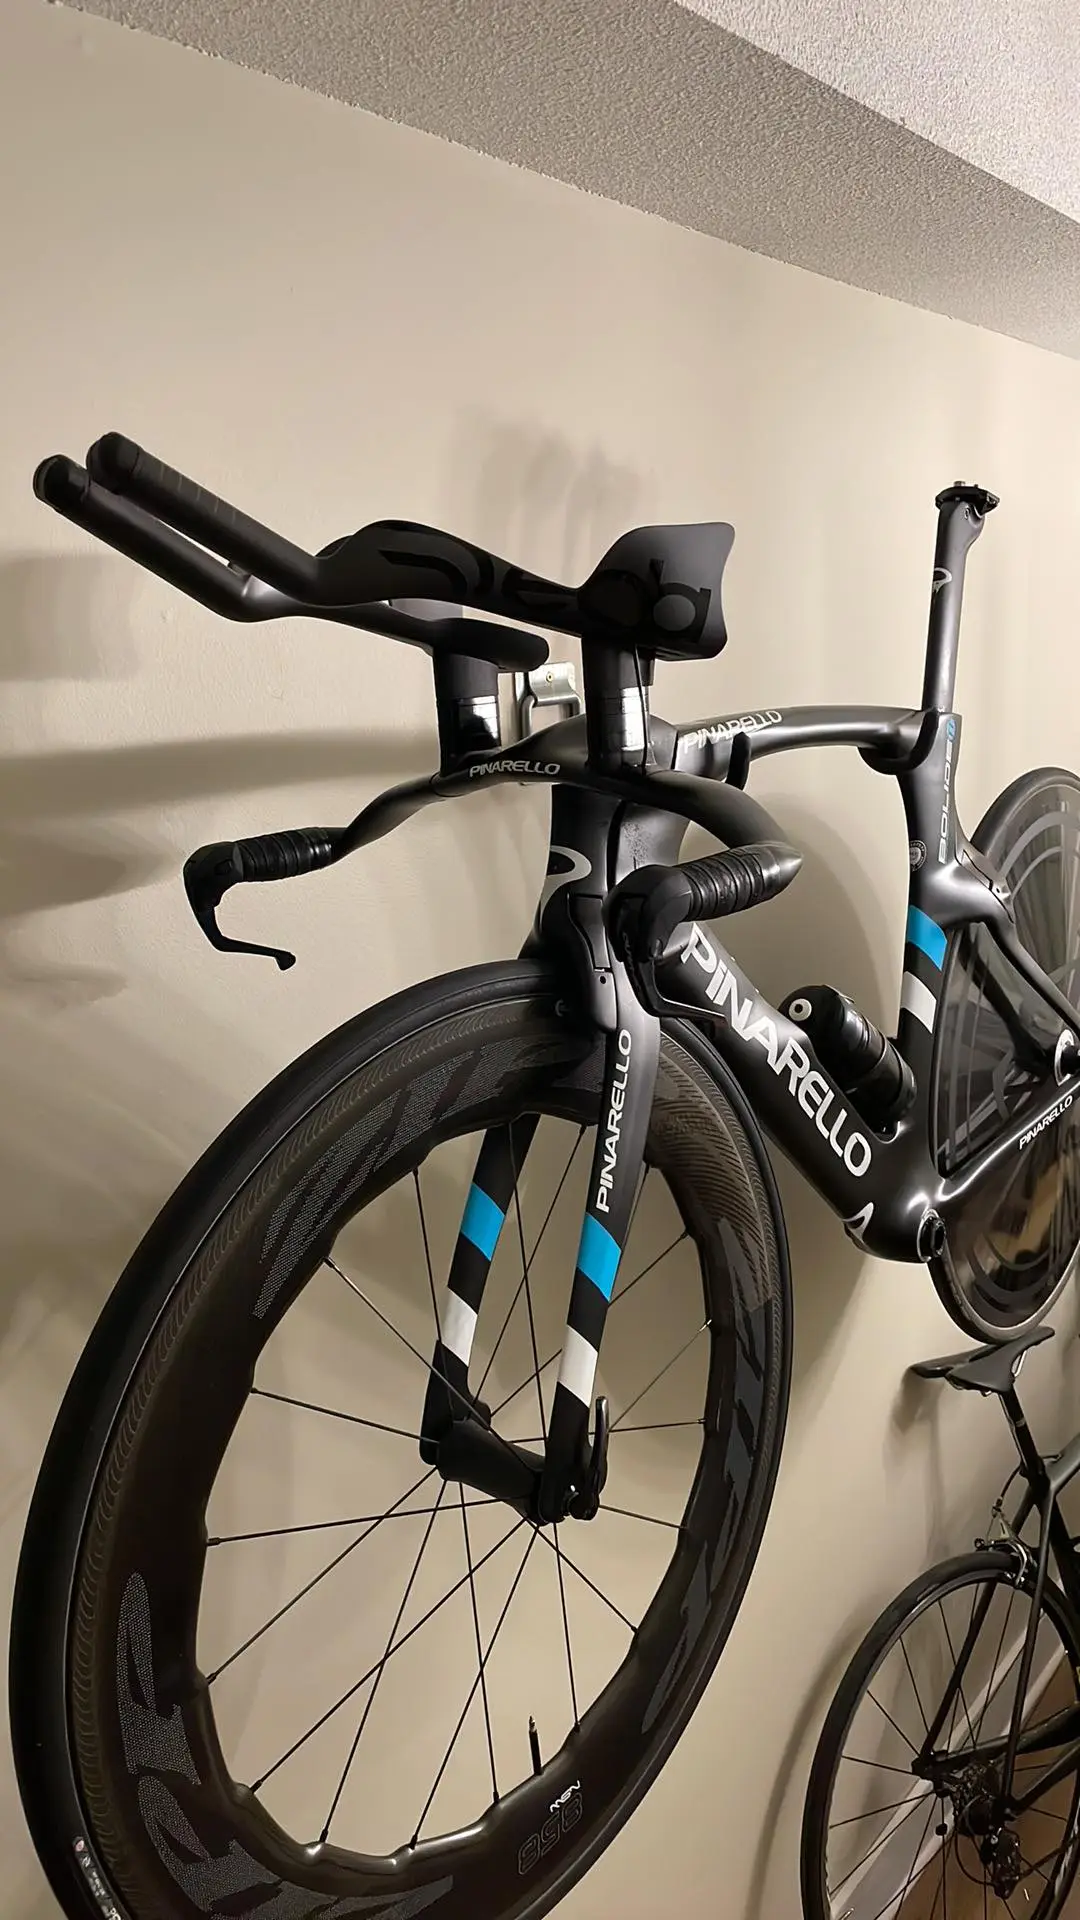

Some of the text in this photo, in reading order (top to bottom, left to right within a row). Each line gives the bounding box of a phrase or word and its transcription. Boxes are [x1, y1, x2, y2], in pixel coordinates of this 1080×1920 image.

[469, 759, 561, 778] PINARELLO
[681, 710, 783, 754] PINARELLO
[938, 738, 953, 865] BOLIDE
[681, 923, 872, 1177] PINARELLO
[595, 1029, 631, 1213] PINARELLO
[1018, 1095, 1074, 1150] PINARELLO
